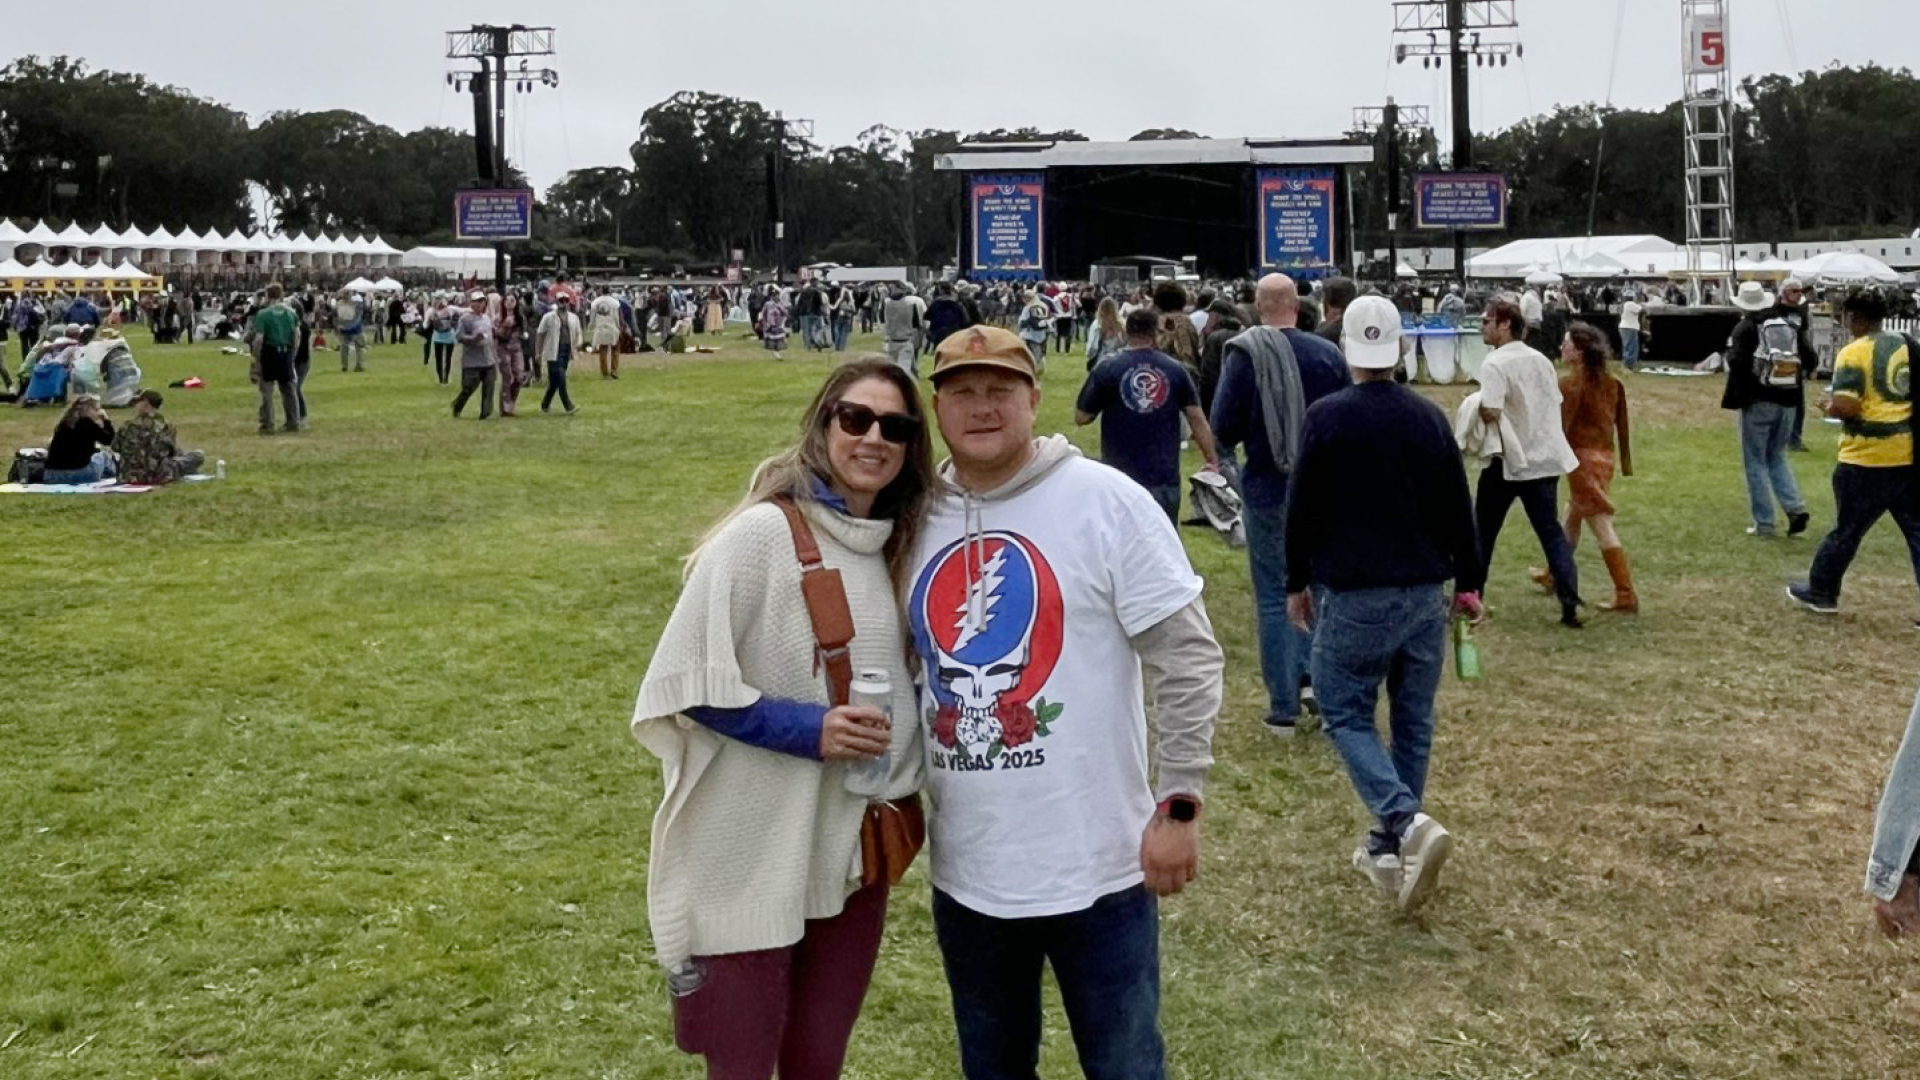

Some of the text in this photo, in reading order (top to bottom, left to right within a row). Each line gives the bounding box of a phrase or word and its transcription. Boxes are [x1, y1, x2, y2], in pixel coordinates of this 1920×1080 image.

[1701, 32, 1725, 66] 5
[947, 753, 994, 771] VEGAS
[1001, 748, 1045, 770] 2025
